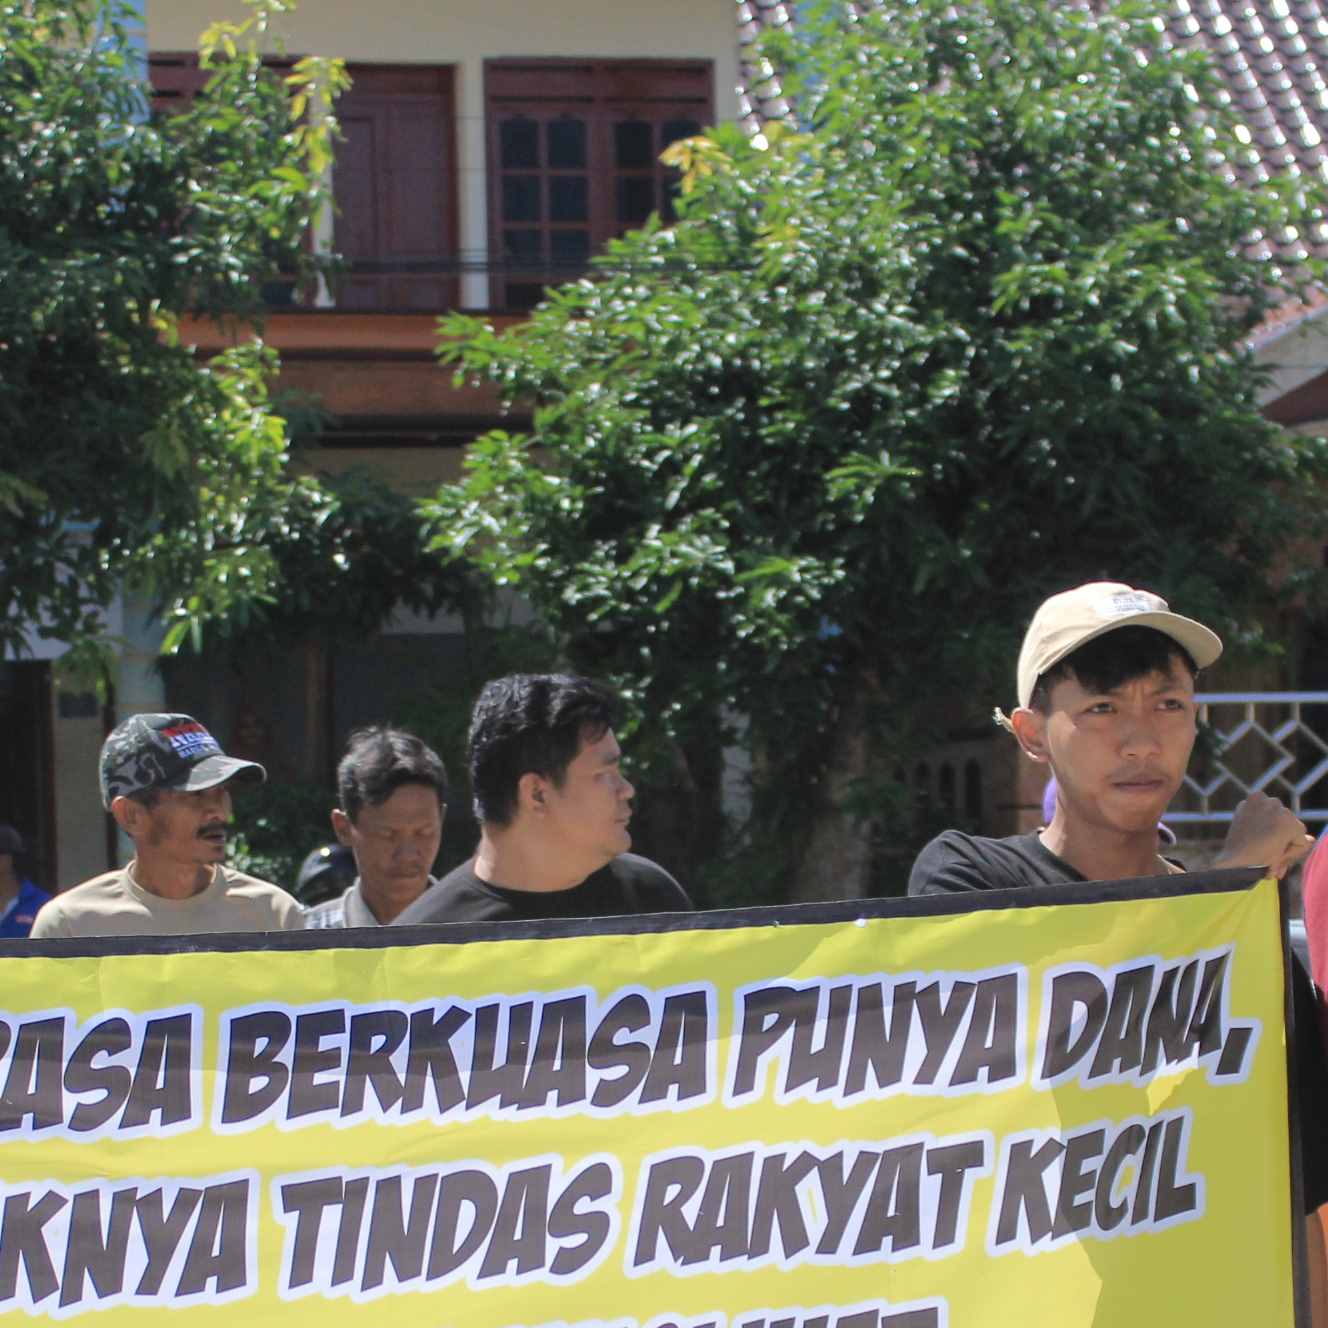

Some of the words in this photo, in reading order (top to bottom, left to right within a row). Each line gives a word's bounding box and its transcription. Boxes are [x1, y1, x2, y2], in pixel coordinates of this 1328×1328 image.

[222, 994, 708, 1121] BERKUASA
[733, 967, 1019, 1097] PUNYA
[1043, 950, 1254, 1081] DANA,
[282, 1163, 614, 1292] TINDAS
[634, 1140, 984, 1267] RAKYAT
[995, 1112, 1198, 1246] KECIL
